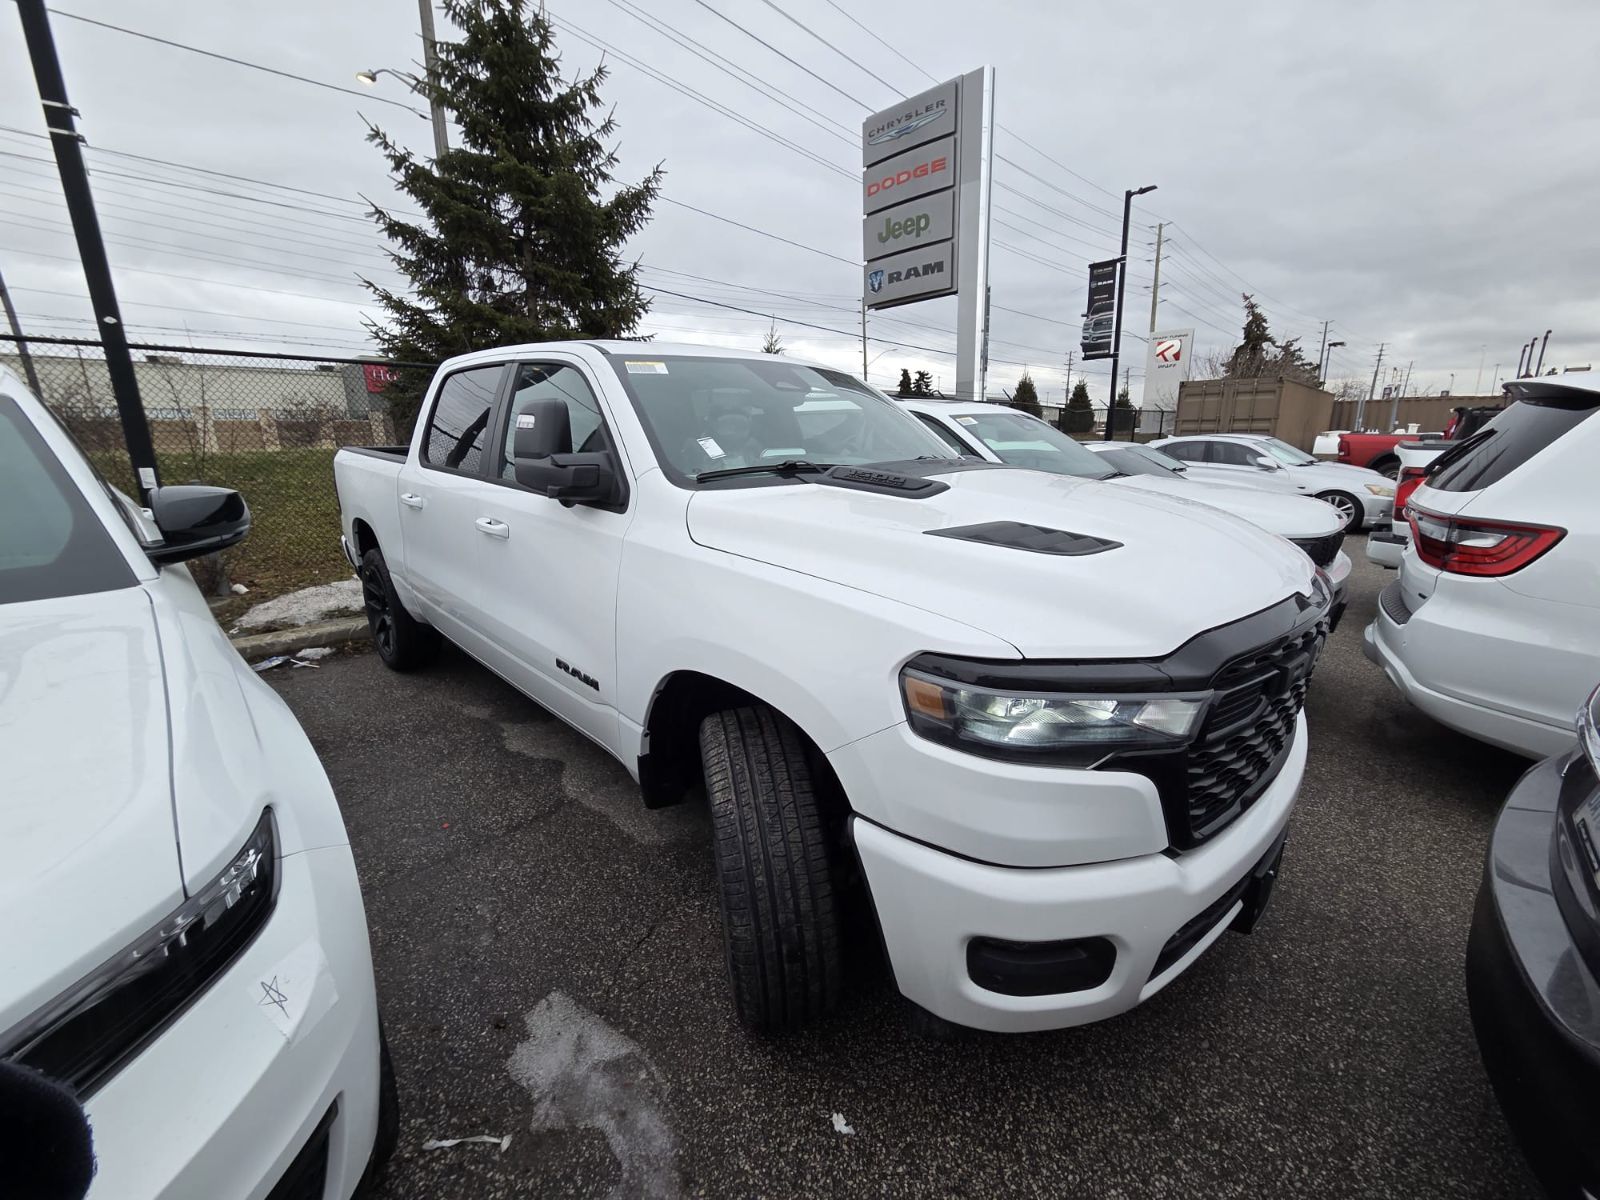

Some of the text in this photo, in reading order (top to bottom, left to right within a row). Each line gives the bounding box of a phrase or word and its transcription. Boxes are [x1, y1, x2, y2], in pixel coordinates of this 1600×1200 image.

[868, 99, 946, 138] CHRYSLER
[867, 157, 946, 197] DODGE
[877, 213, 931, 243] Jeep
[887, 260, 944, 285] RAM
[555, 657, 600, 691] RAM
